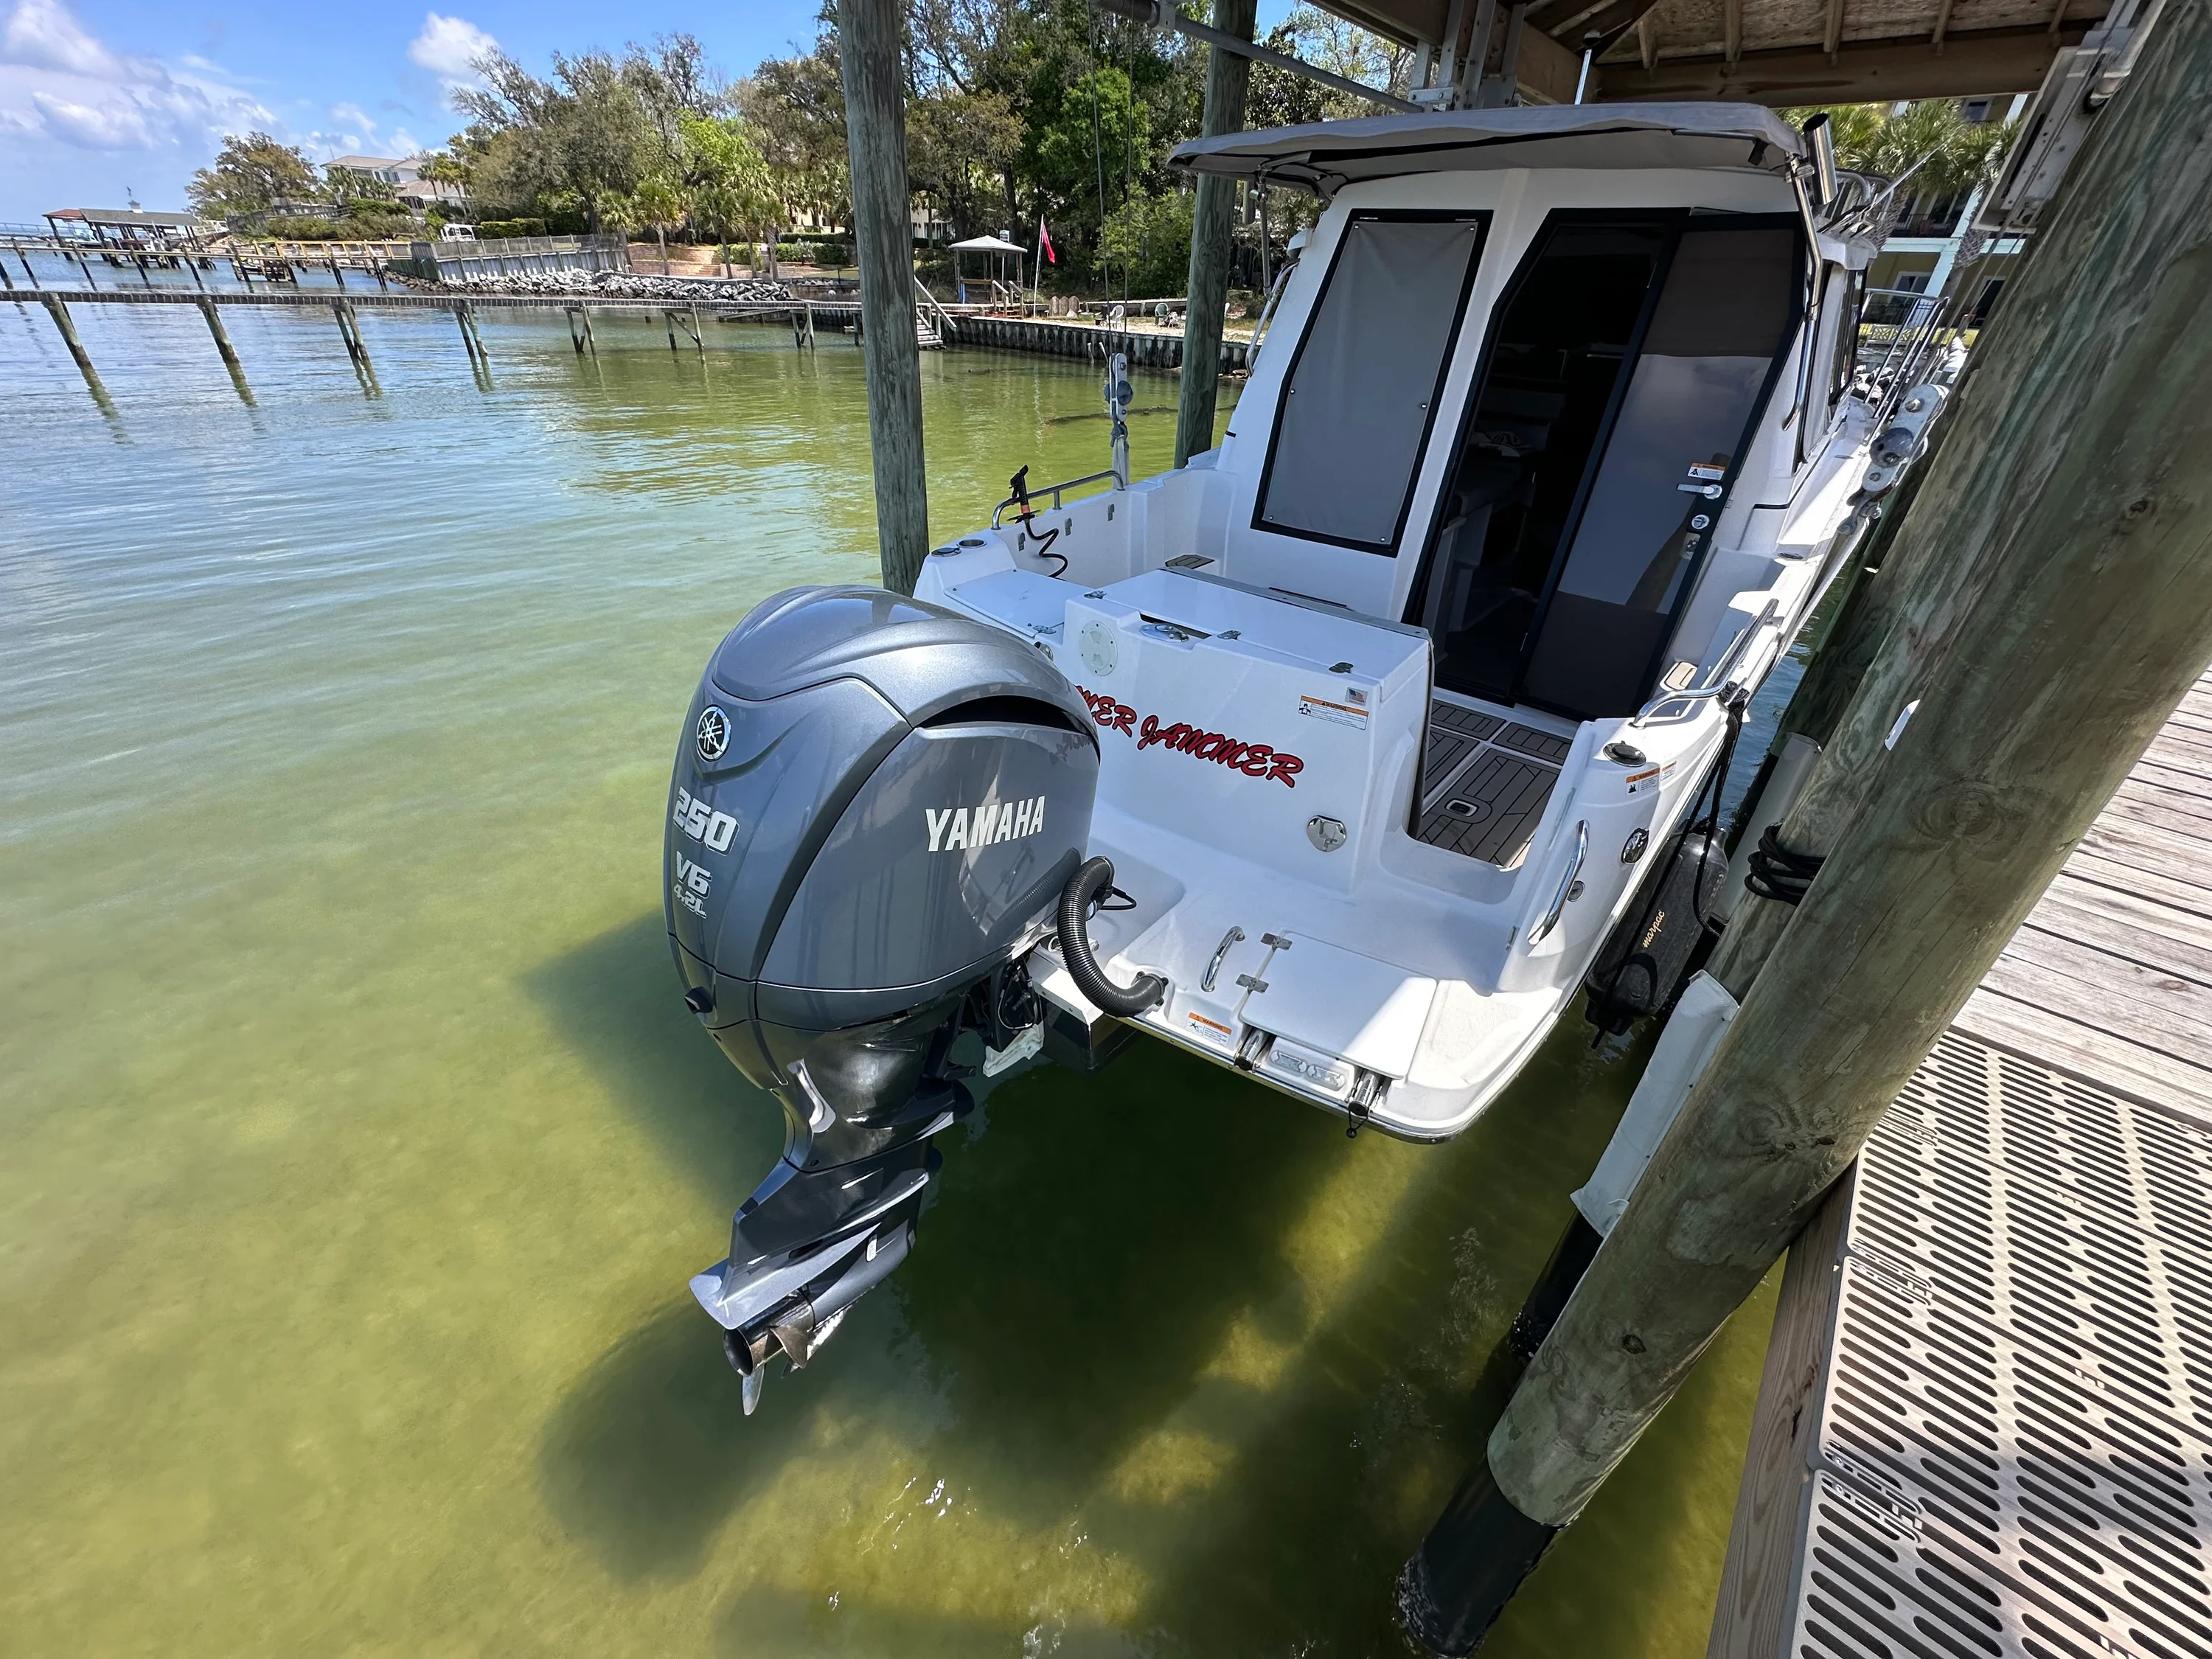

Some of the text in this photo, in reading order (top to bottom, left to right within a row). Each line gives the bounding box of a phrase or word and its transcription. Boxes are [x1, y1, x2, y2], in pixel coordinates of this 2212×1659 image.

[1138, 714, 1304, 788] JAMMER
[672, 786, 740, 856] 250
[925, 796, 1045, 852] YAMAHA
[674, 883, 706, 919] 4.2L
[676, 851, 712, 899] V6
[1643, 909, 1665, 947] marpac
